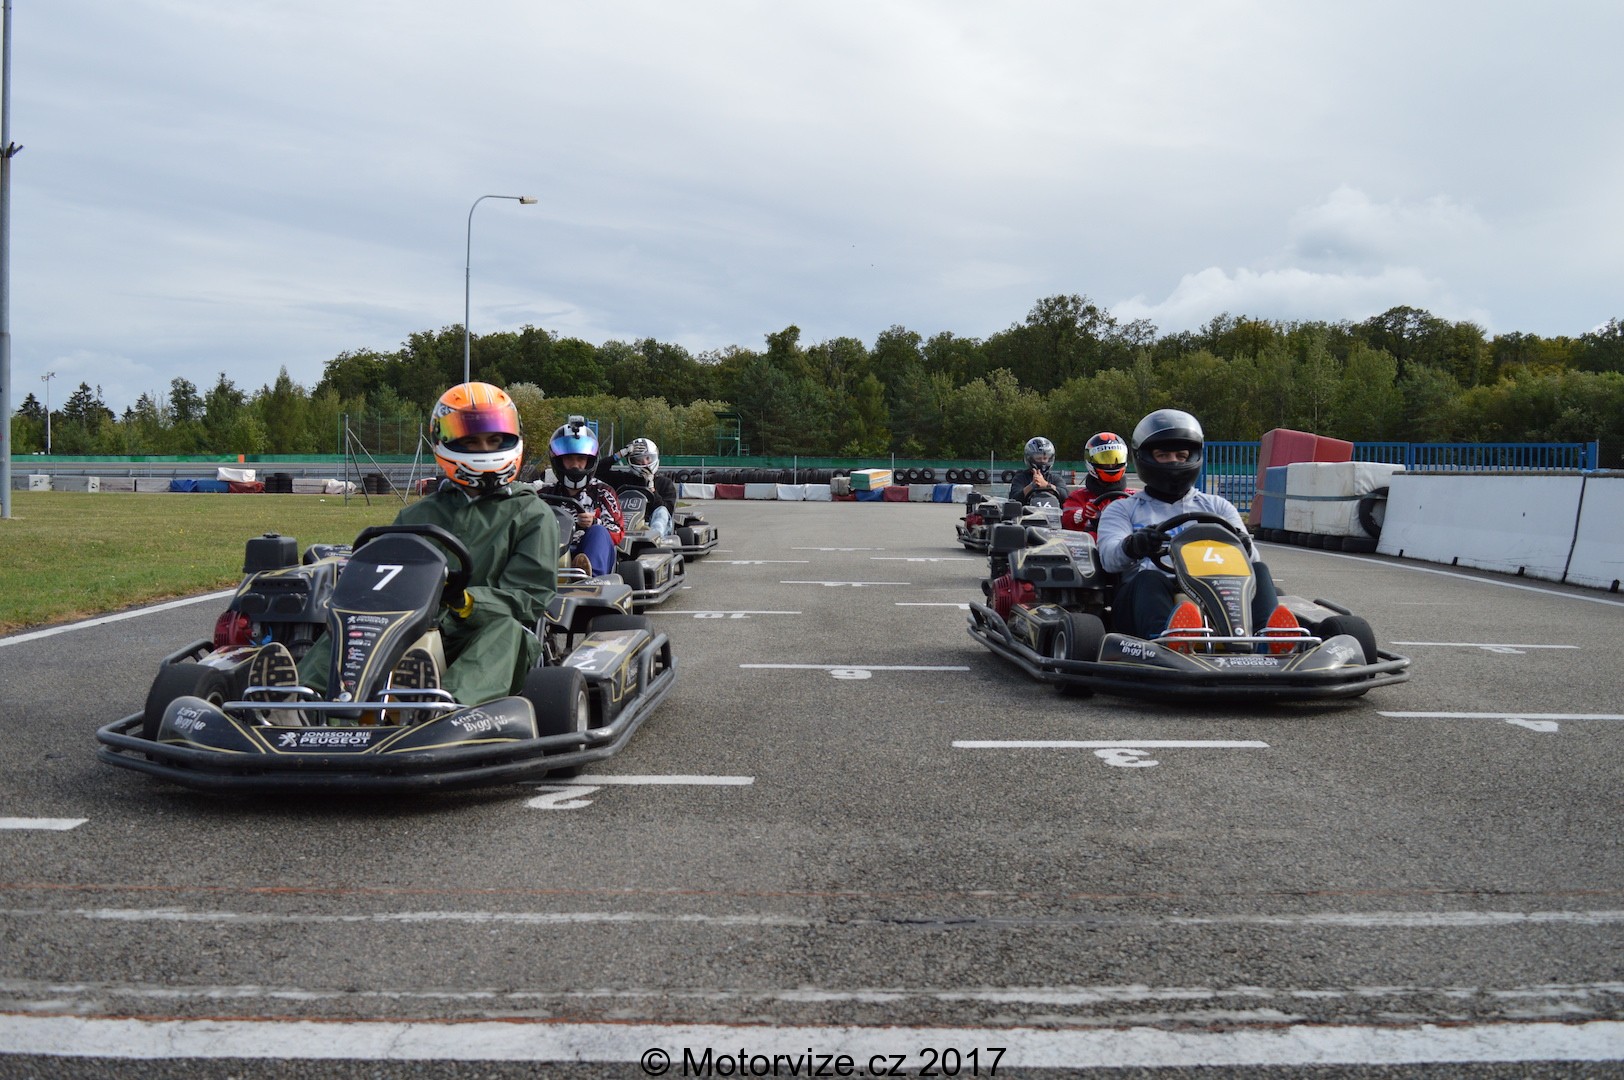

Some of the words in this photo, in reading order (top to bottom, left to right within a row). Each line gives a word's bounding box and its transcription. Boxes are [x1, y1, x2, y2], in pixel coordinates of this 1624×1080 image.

[1203, 547, 1224, 564] 4
[372, 565, 404, 590] 7
[300, 737, 371, 745] PEUGEOT
[1093, 748, 1160, 768] 3
[523, 785, 600, 809] 2
